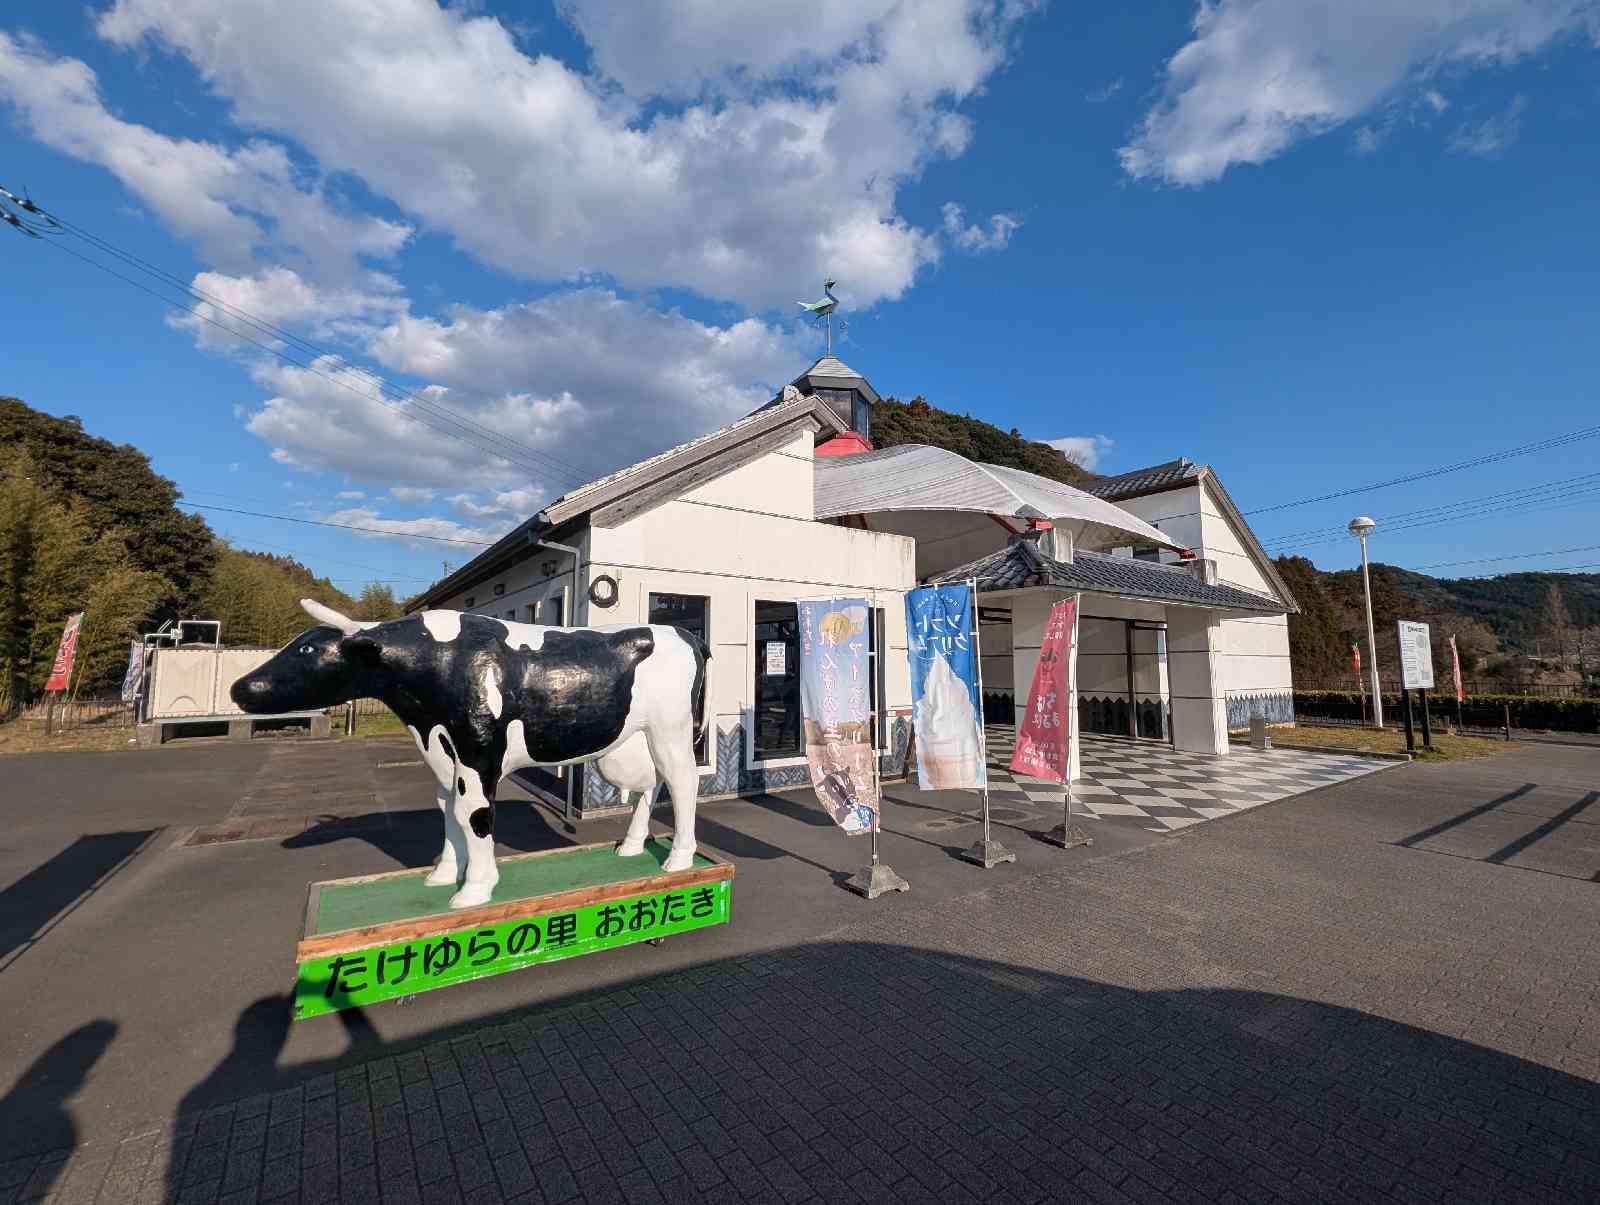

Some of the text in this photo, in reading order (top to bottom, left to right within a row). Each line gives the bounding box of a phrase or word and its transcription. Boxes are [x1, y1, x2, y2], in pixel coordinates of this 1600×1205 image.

[324, 887, 715, 999] たけゆらの里 おおたき
